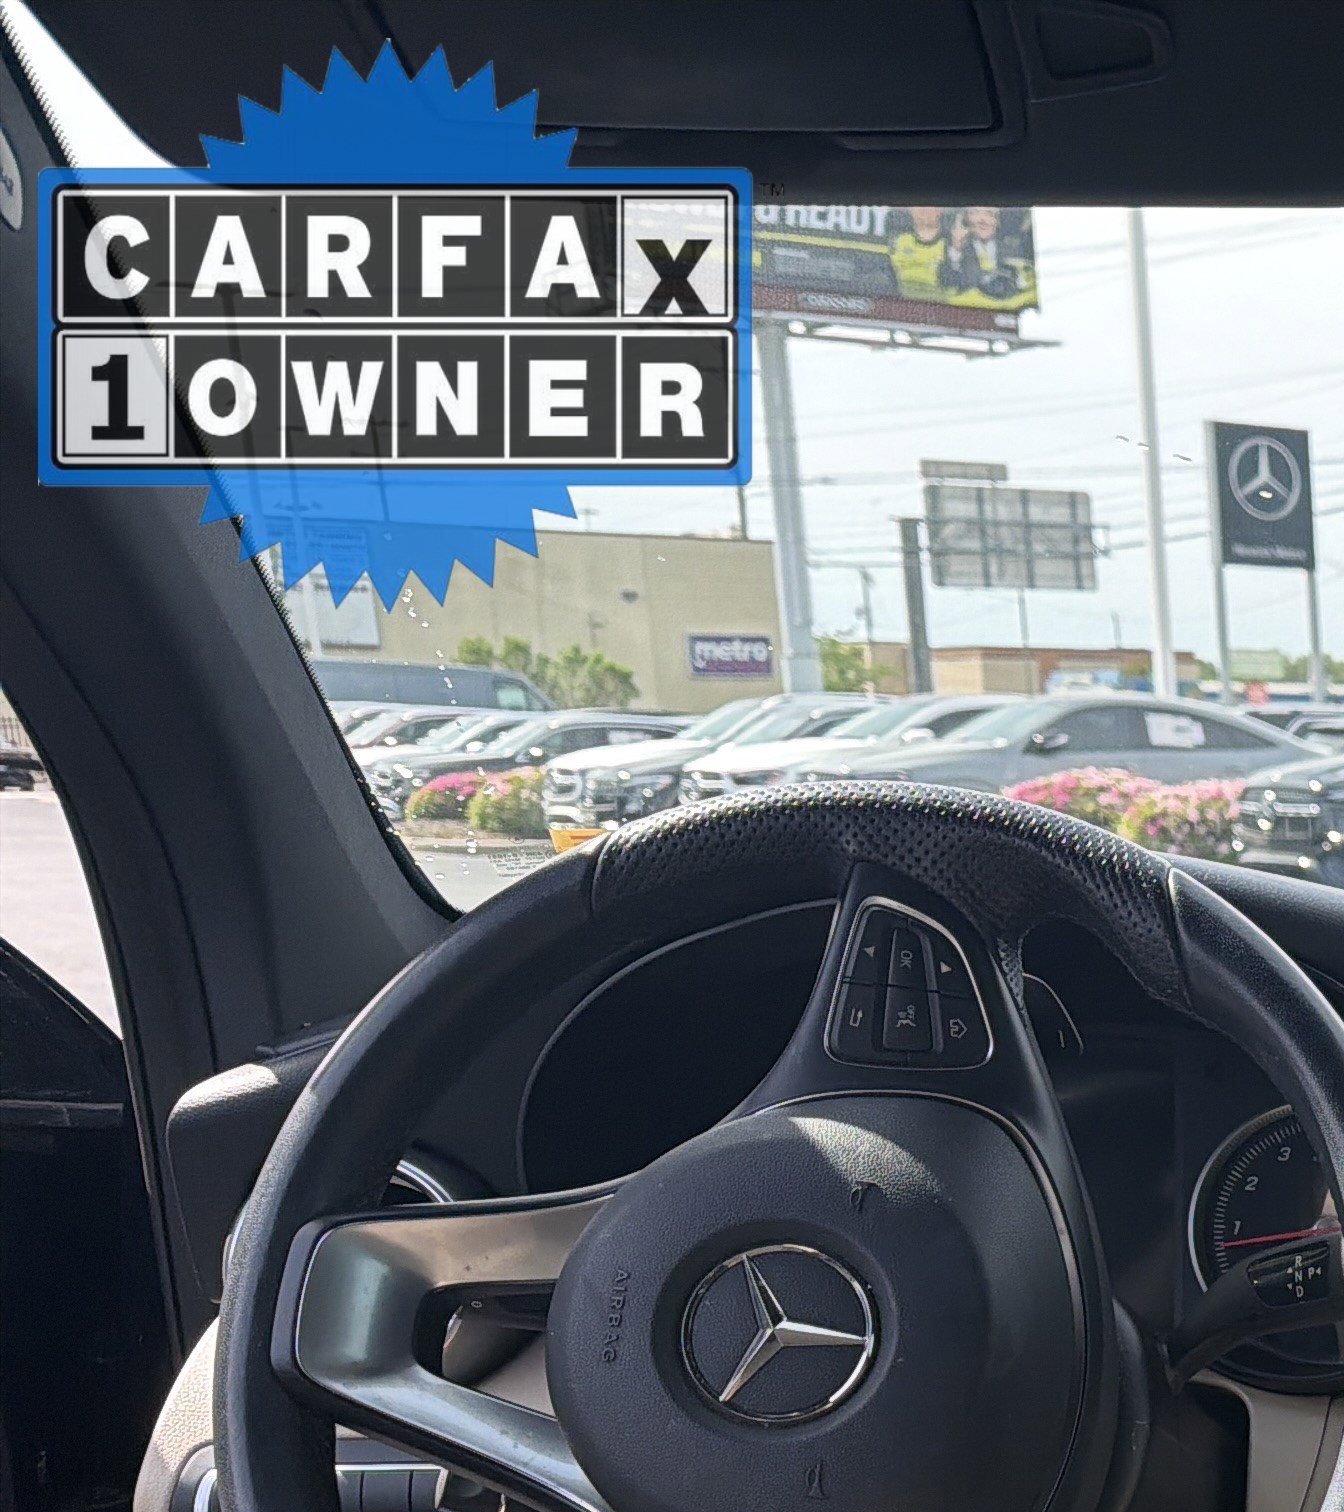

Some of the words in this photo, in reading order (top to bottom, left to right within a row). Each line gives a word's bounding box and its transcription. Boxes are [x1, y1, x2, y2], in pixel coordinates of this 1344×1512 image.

[900, 950, 913, 971] OK
[1277, 1147, 1292, 1162] 3
[1244, 1176, 1259, 1191] 2
[1233, 1221, 1241, 1236] 1
[1295, 1256, 1302, 1267] R
[1295, 1271, 1302, 1282] N
[1308, 1268, 1315, 1280] P
[1296, 1286, 1304, 1298] D
[603, 1269, 630, 1361] AIRBAG
